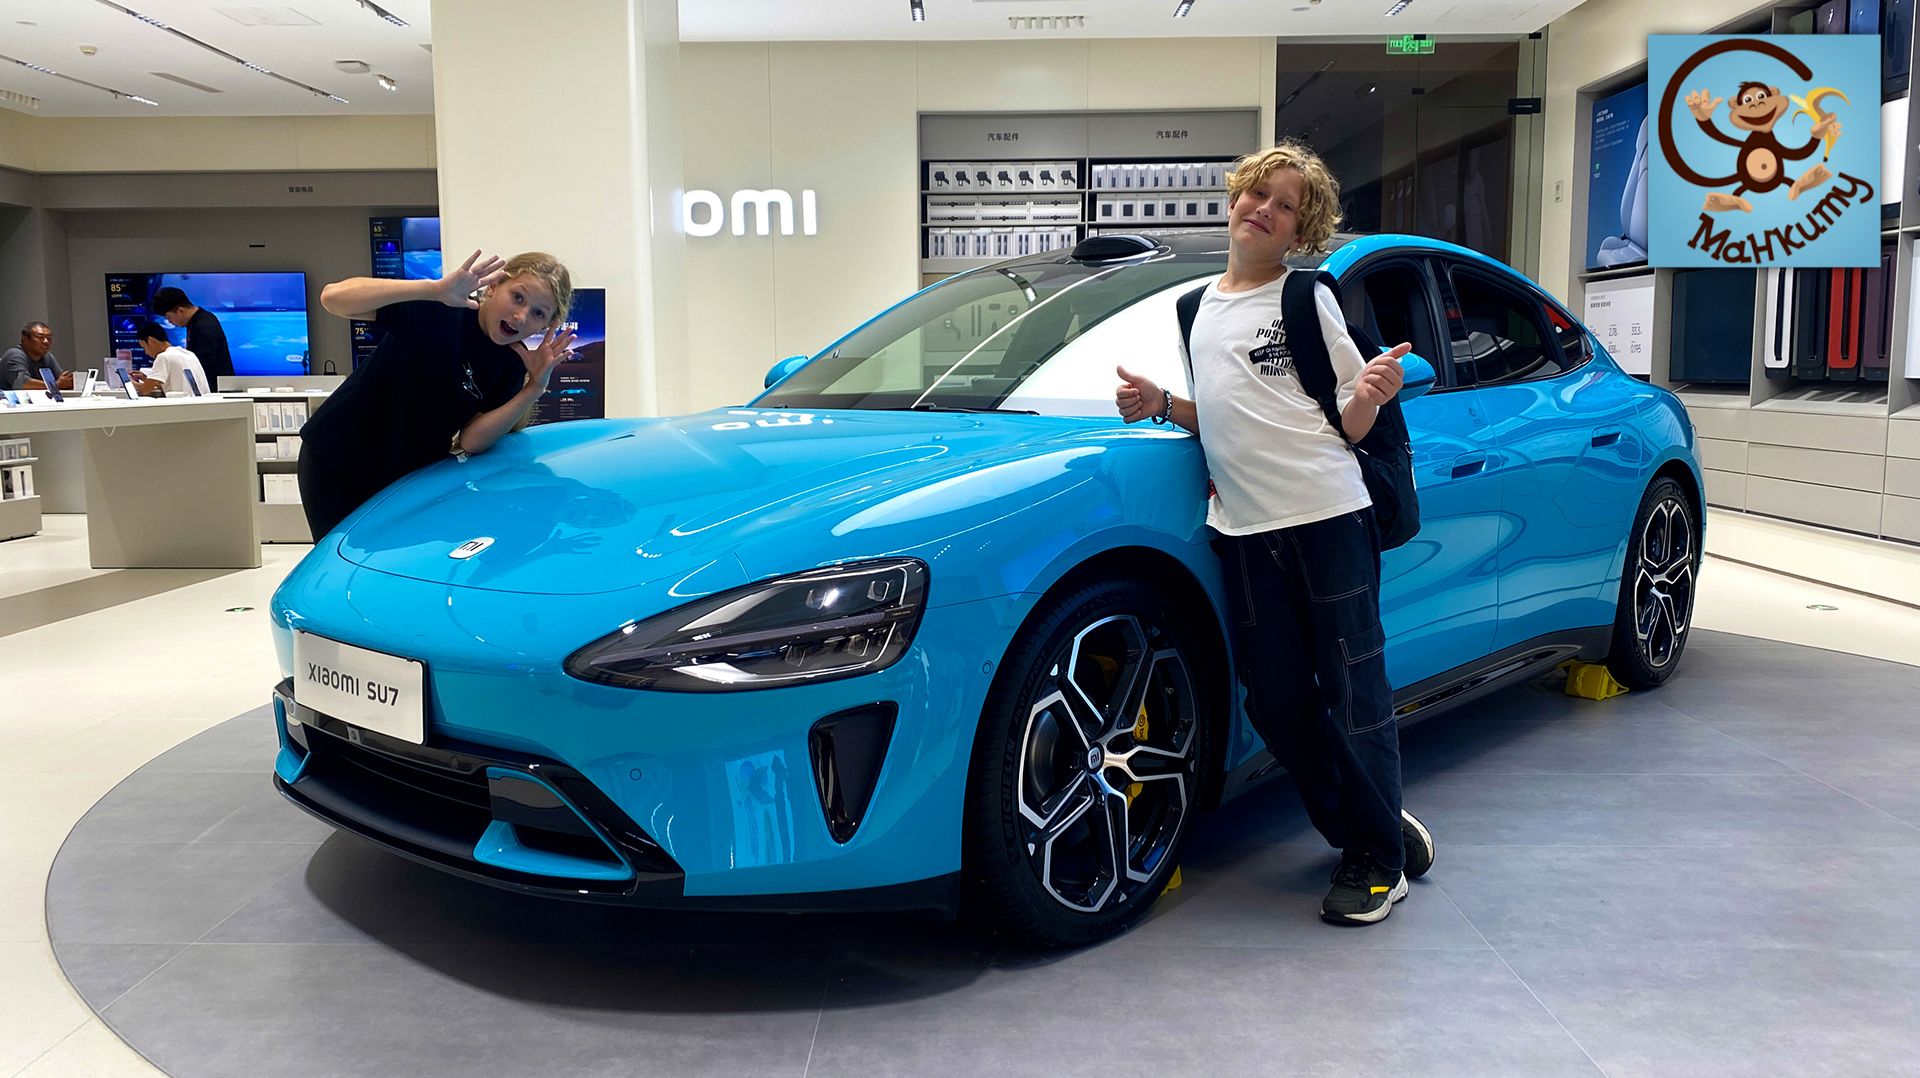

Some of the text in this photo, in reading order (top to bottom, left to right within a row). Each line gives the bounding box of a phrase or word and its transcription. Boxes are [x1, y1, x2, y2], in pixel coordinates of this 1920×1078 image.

[987, 132, 1020, 141] 汽车配件
[1155, 130, 1189, 139] 汽车配件
[110, 283, 121, 292] 85
[355, 327, 365, 335] 75
[367, 681, 399, 707] SU7
[1002, 738, 1017, 839] MICHELIN
